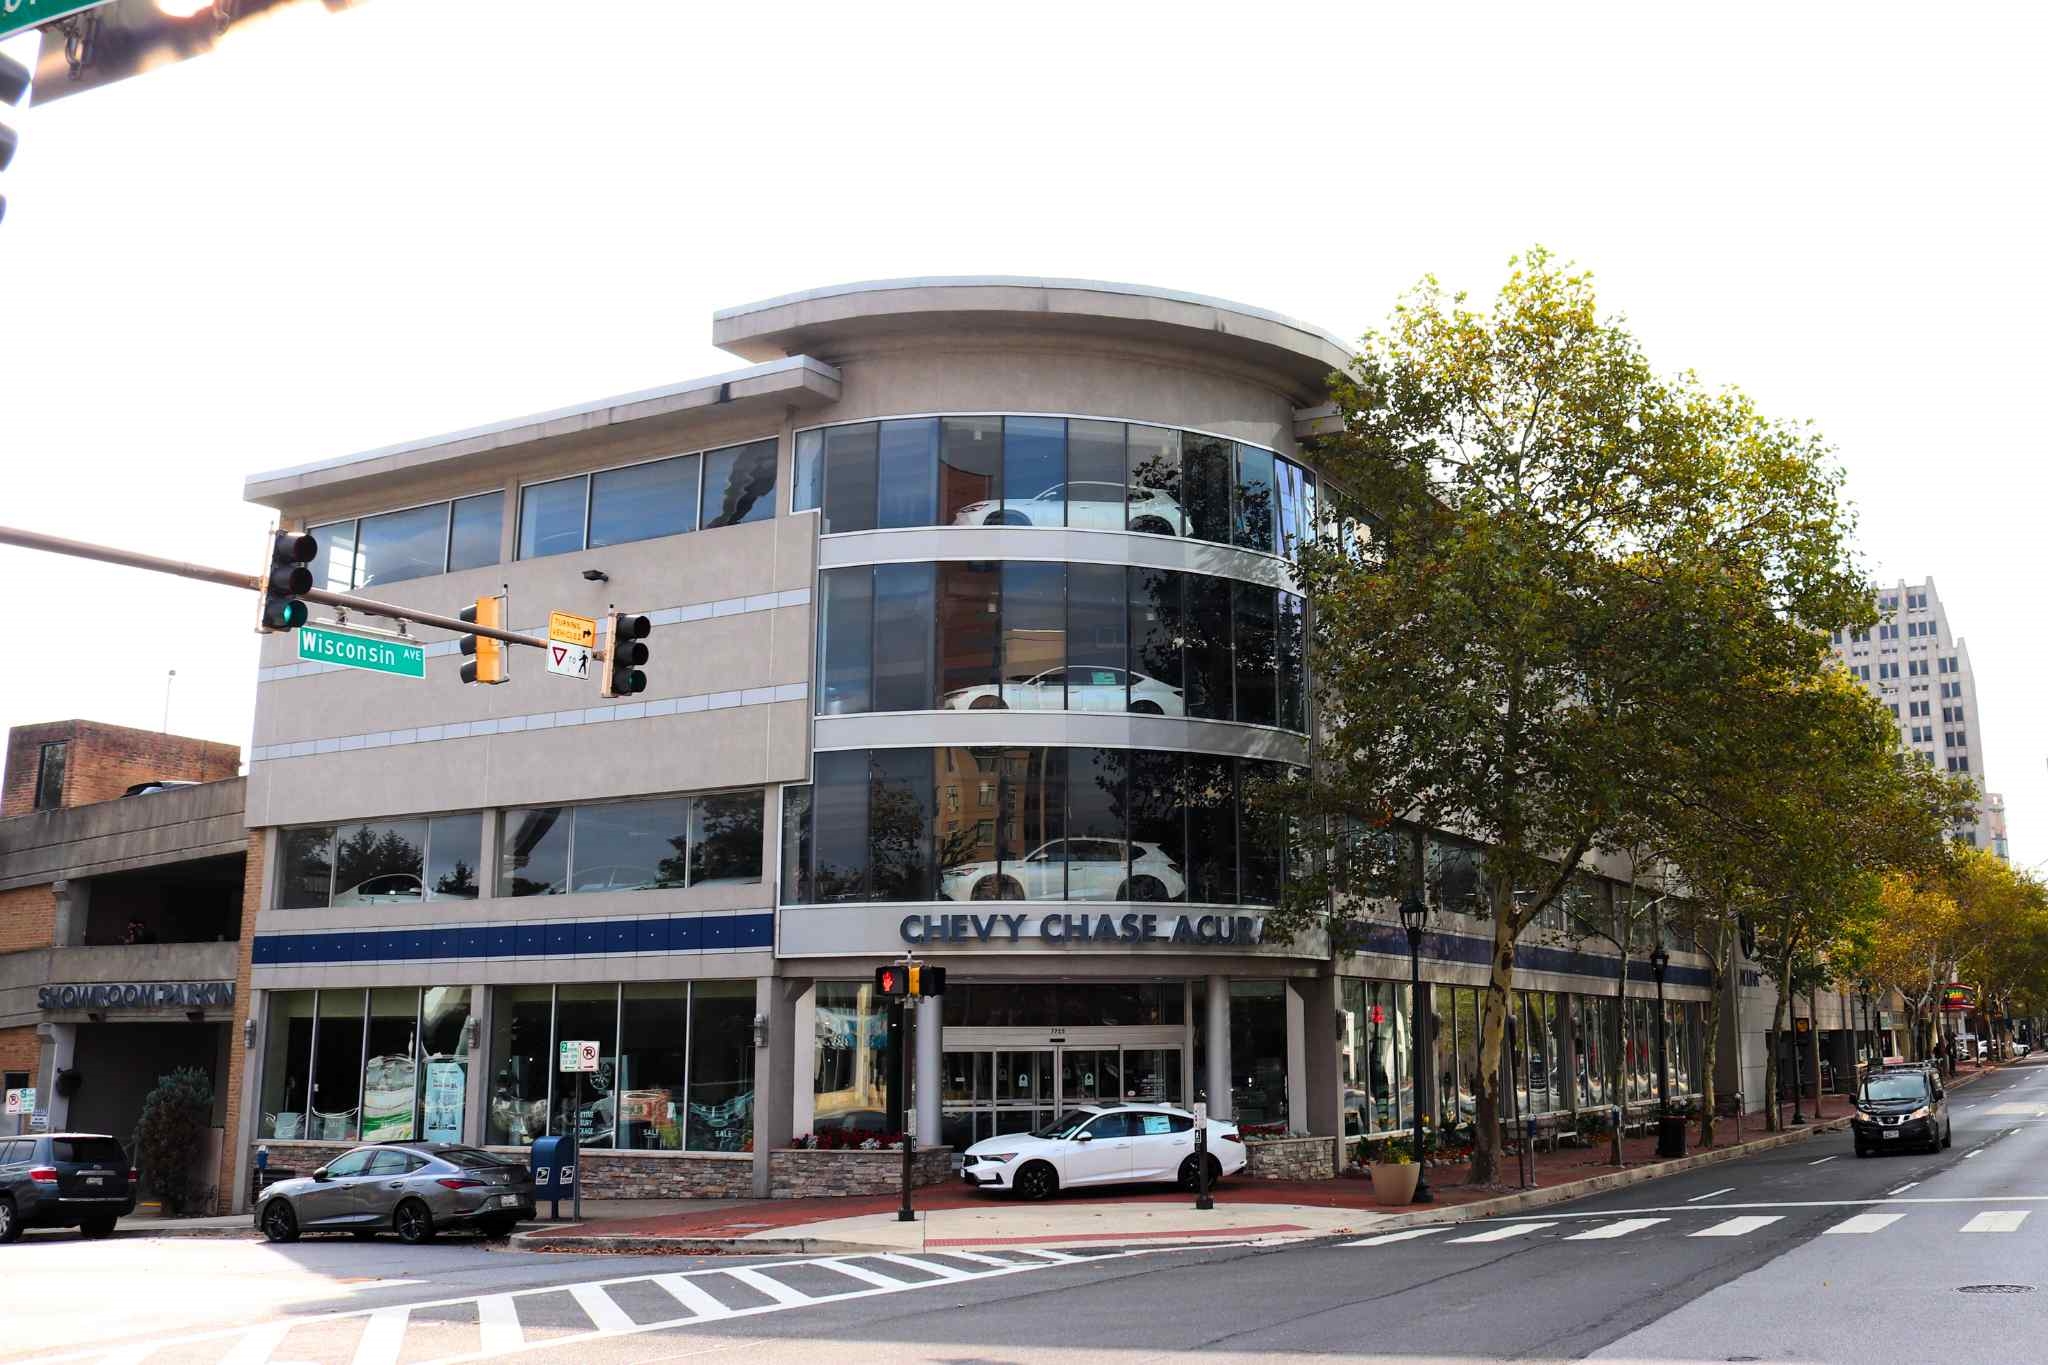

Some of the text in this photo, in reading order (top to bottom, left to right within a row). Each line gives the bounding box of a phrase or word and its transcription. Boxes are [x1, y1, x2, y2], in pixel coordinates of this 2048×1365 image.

[302, 631, 422, 665] Wisconsin AVE
[900, 914, 1027, 944] CHEVY
[1040, 914, 1157, 944] CHASE
[37, 983, 234, 1009] SHOWROOM PARKIN
